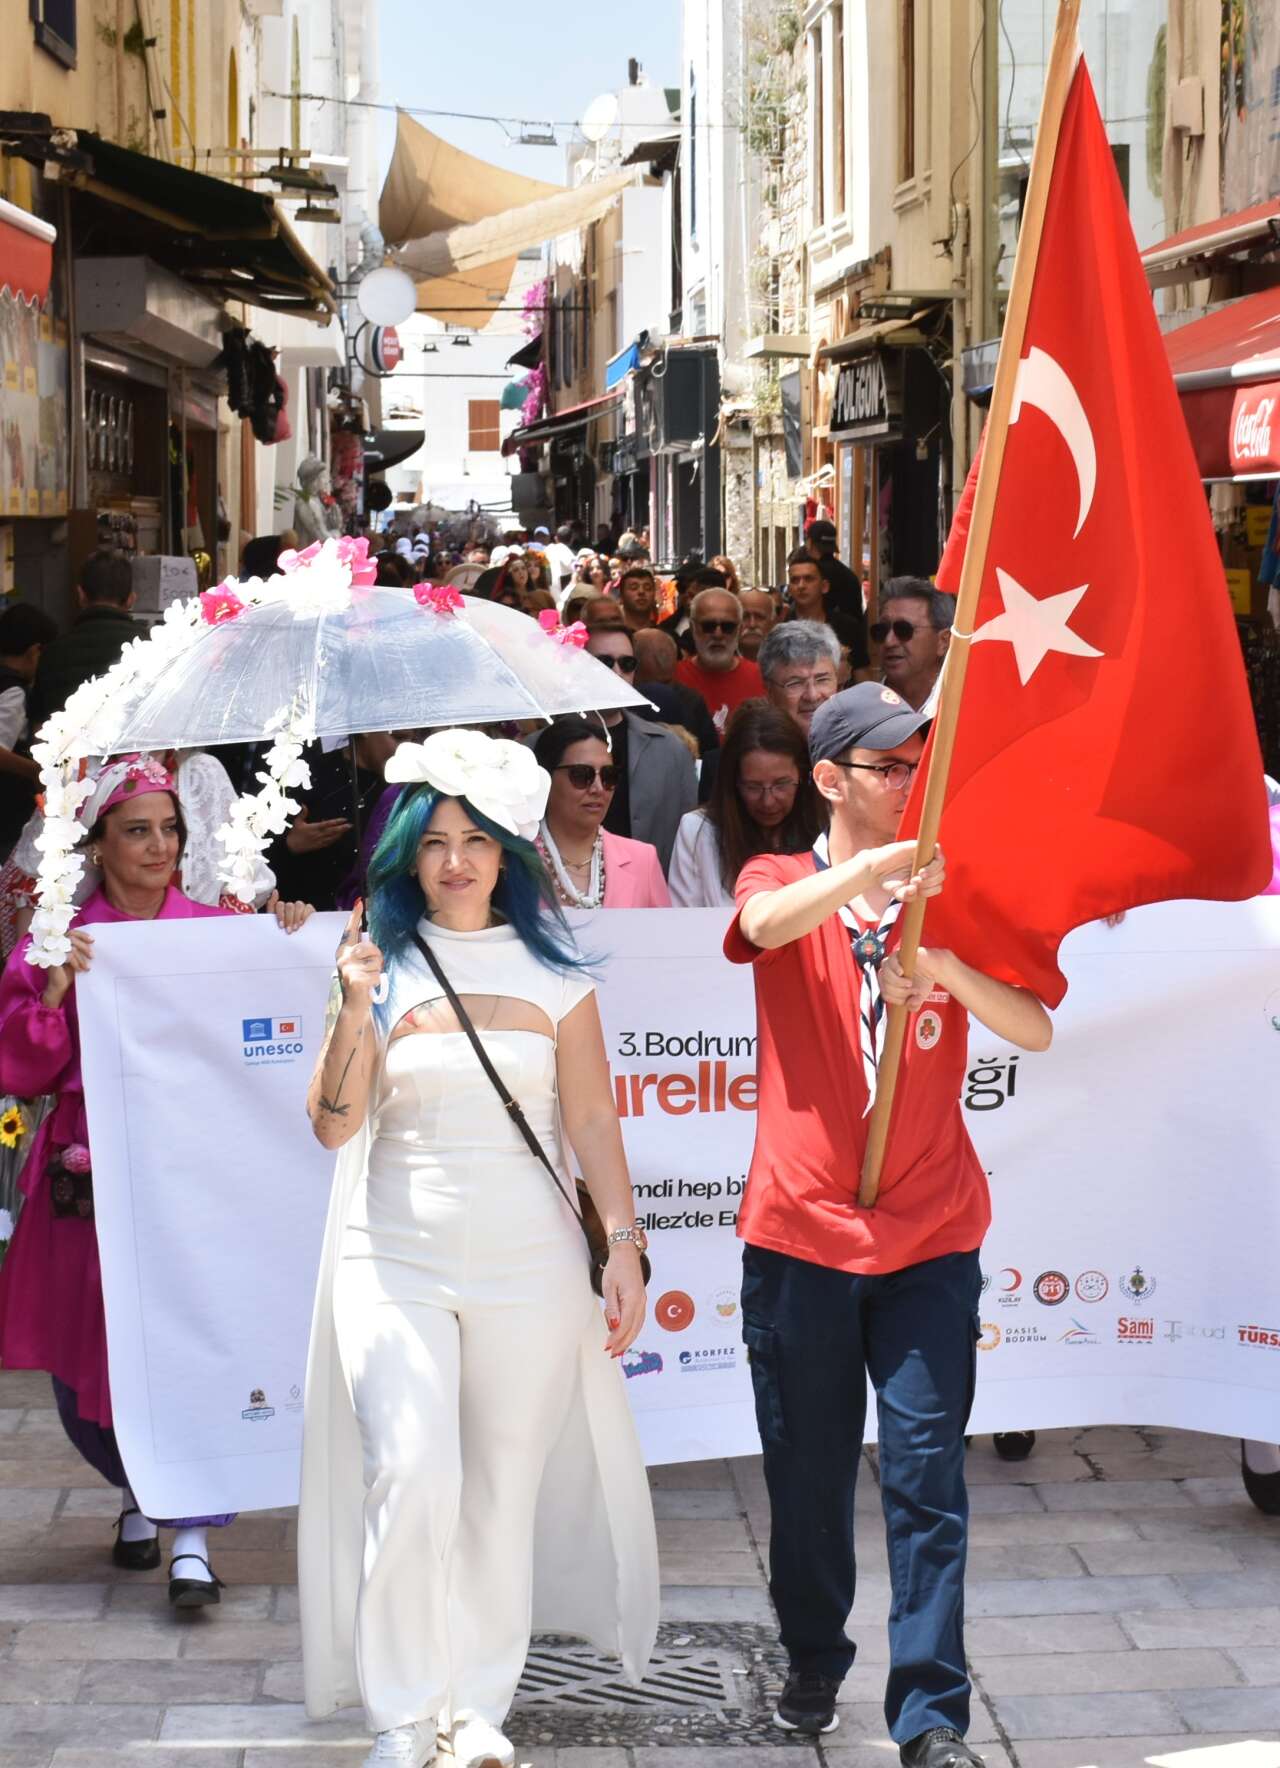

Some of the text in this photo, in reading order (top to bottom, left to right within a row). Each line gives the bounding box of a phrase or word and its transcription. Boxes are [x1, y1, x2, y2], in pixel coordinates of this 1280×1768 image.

[243, 1043, 304, 1057] unesco
[607, 1060, 759, 1117] ırelle
[678, 1179, 722, 1200] hep
[1005, 1327, 1038, 1335] OASIS
[1117, 1317, 1154, 1335] Sami
[1005, 1335, 1047, 1344] BODRUM
[1238, 1325, 1280, 1347] TÜRS
